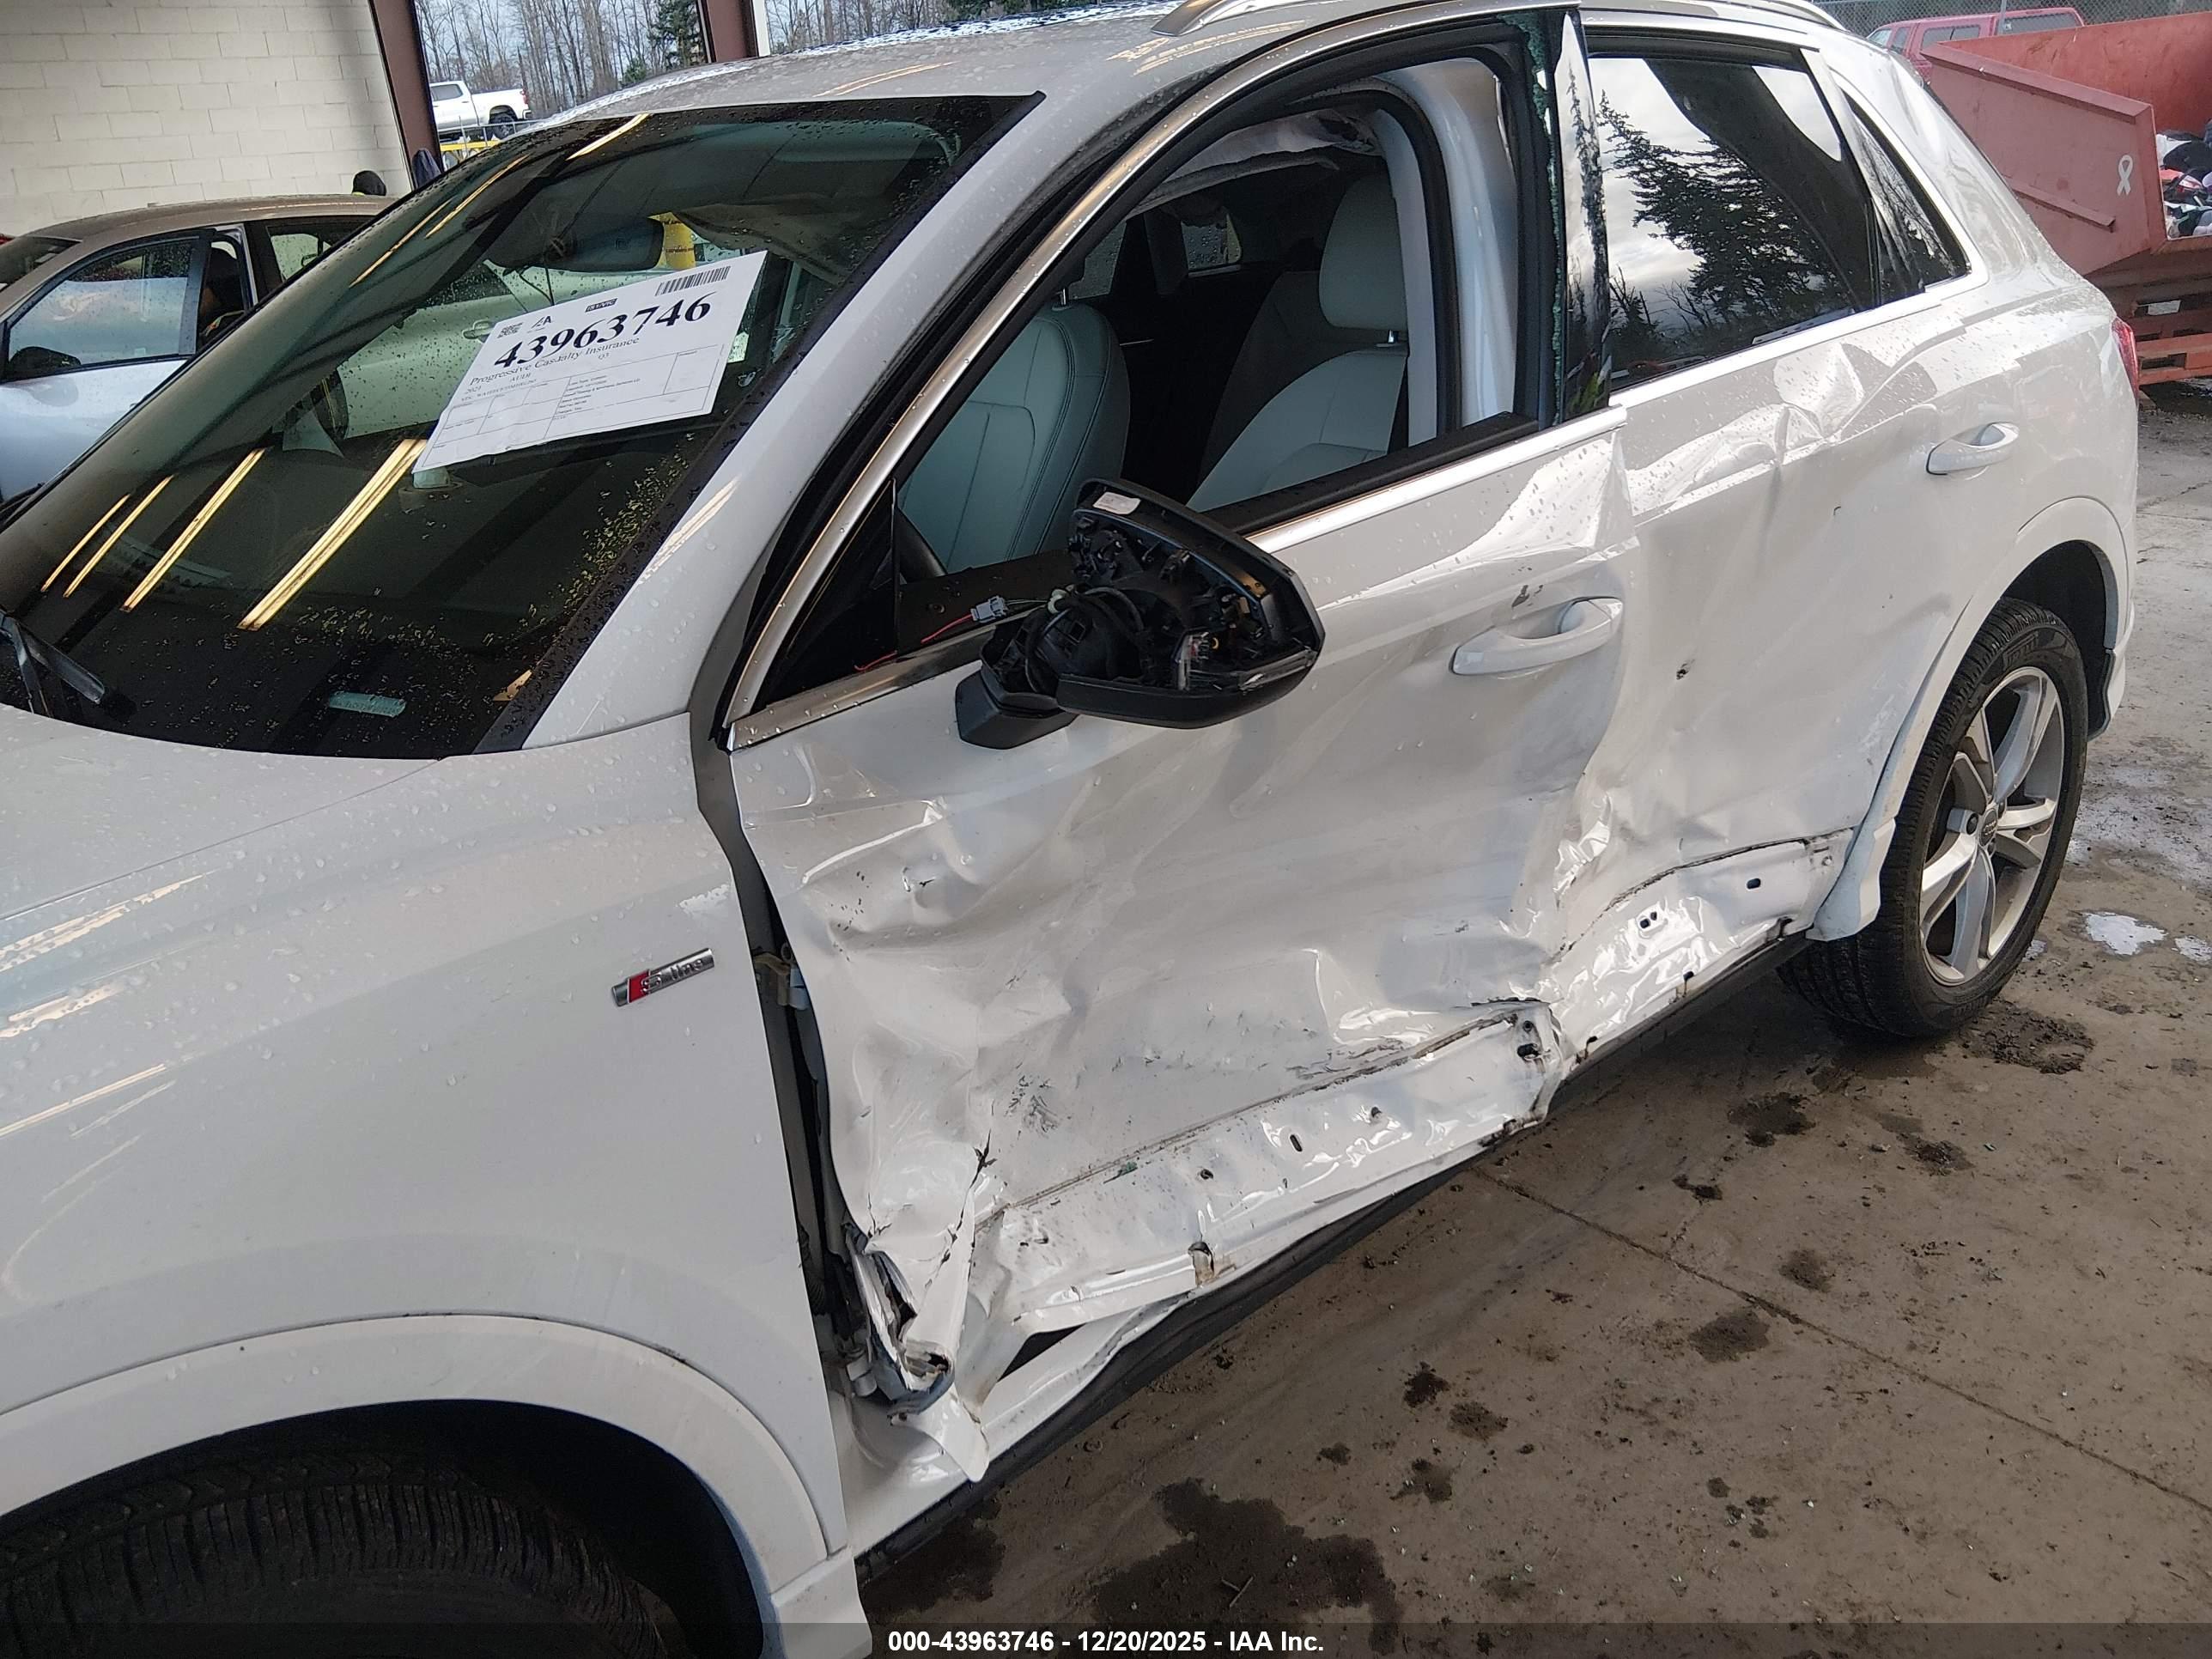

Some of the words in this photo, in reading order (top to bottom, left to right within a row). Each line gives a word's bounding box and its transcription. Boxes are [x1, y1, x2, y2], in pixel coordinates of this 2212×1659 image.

[494, 291, 716, 368] 43963746
[470, 364, 532, 386] Progressive
[586, 337, 640, 355] Insurance
[640, 971, 662, 995] S
[669, 958, 703, 981] line
